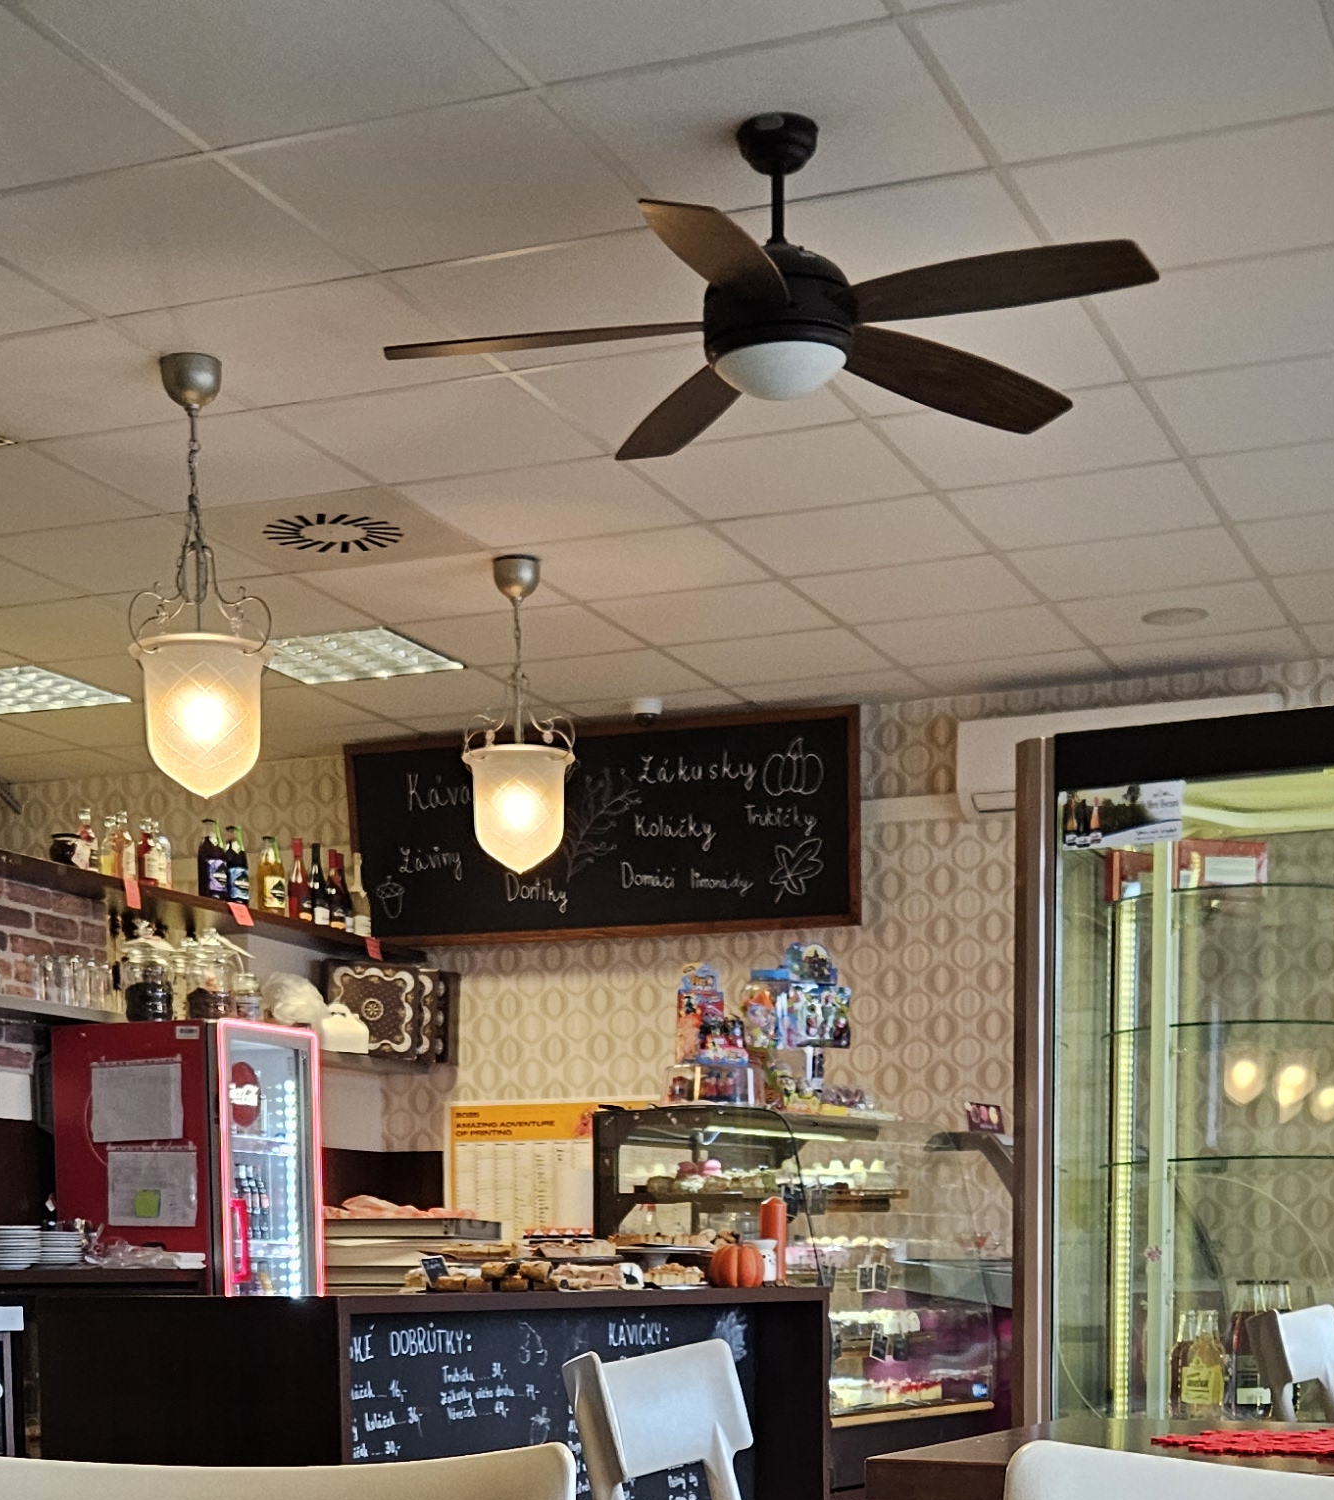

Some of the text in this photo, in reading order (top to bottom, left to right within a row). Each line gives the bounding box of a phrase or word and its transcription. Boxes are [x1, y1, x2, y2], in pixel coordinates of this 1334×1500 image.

[634, 812, 717, 852] Koláčky
[500, 1119, 556, 1128] ADVENTURE
[470, 1128, 513, 1137] PRINTING
